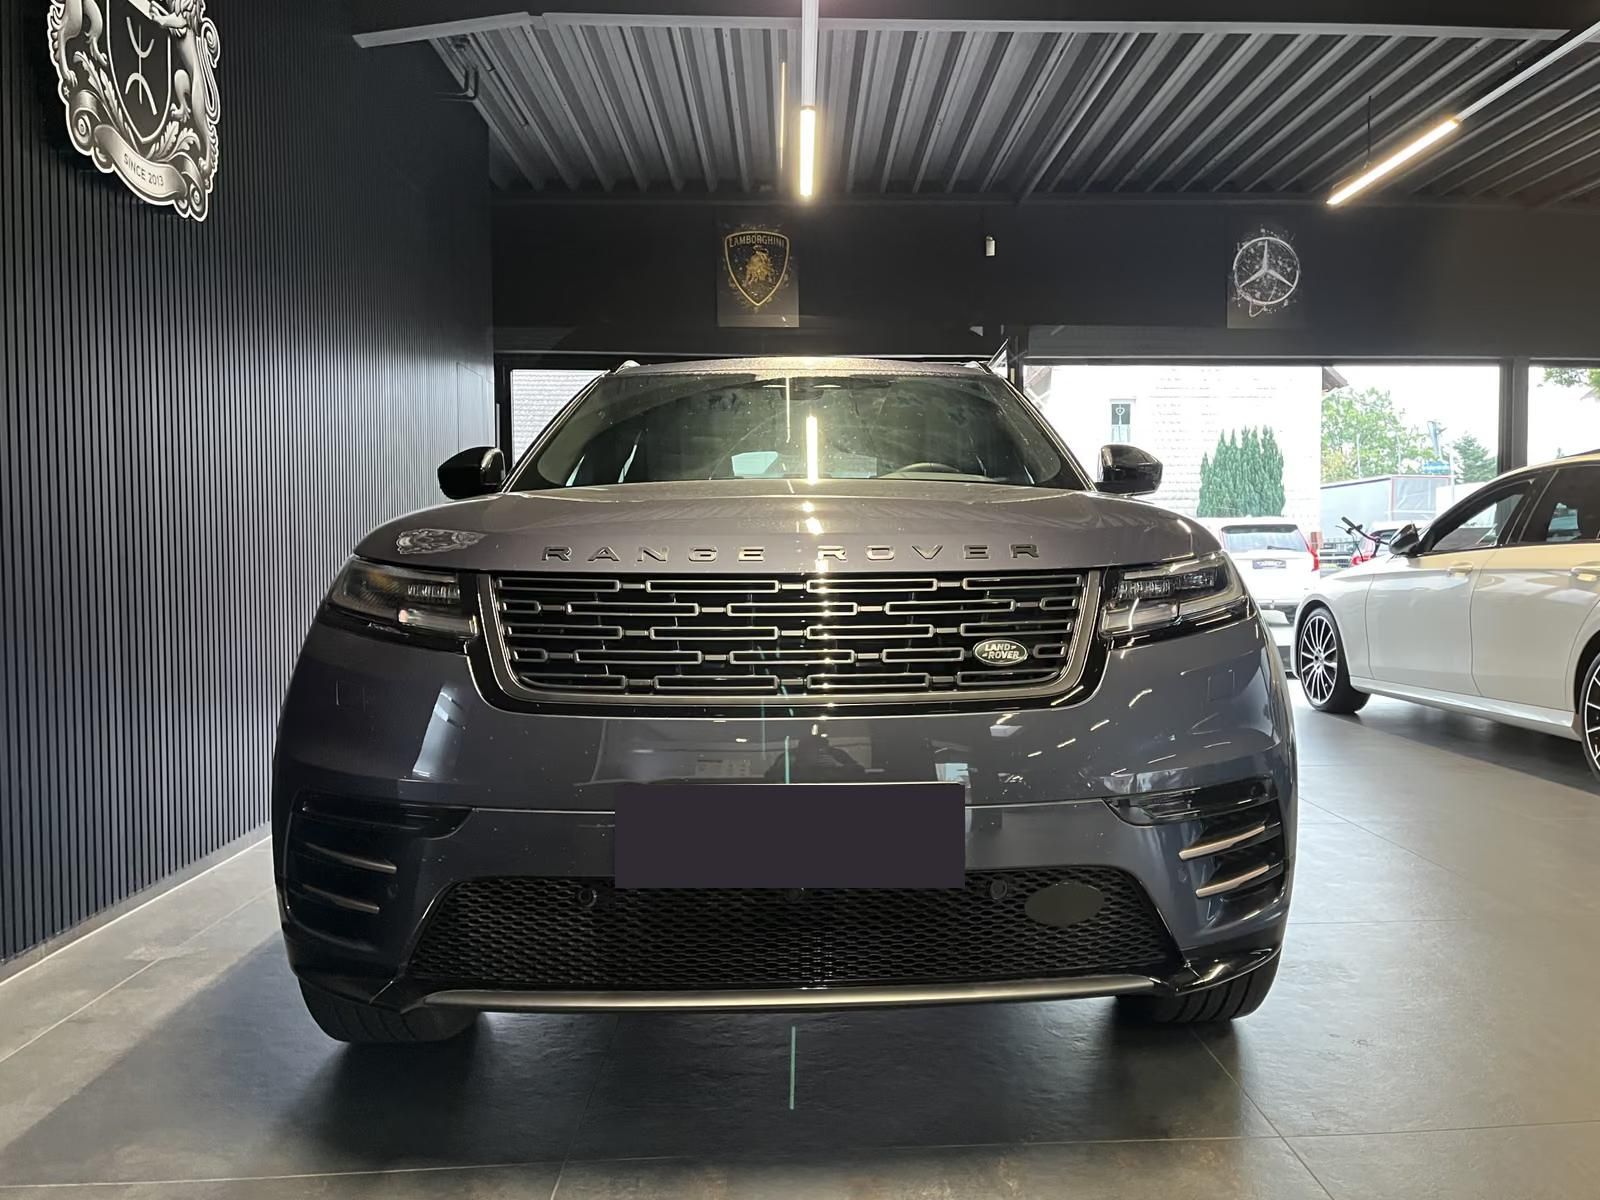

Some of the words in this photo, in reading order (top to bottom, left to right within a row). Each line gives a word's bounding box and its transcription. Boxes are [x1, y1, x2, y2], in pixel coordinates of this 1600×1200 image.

[123, 153, 146, 181] SINCE
[148, 172, 164, 187] 2013
[729, 234, 785, 248] LAMBORGHINI
[541, 545, 765, 563] RANGE
[816, 542, 1040, 561] ROVER
[984, 643, 1011, 652] LAND
[987, 650, 1020, 660] ROVER
